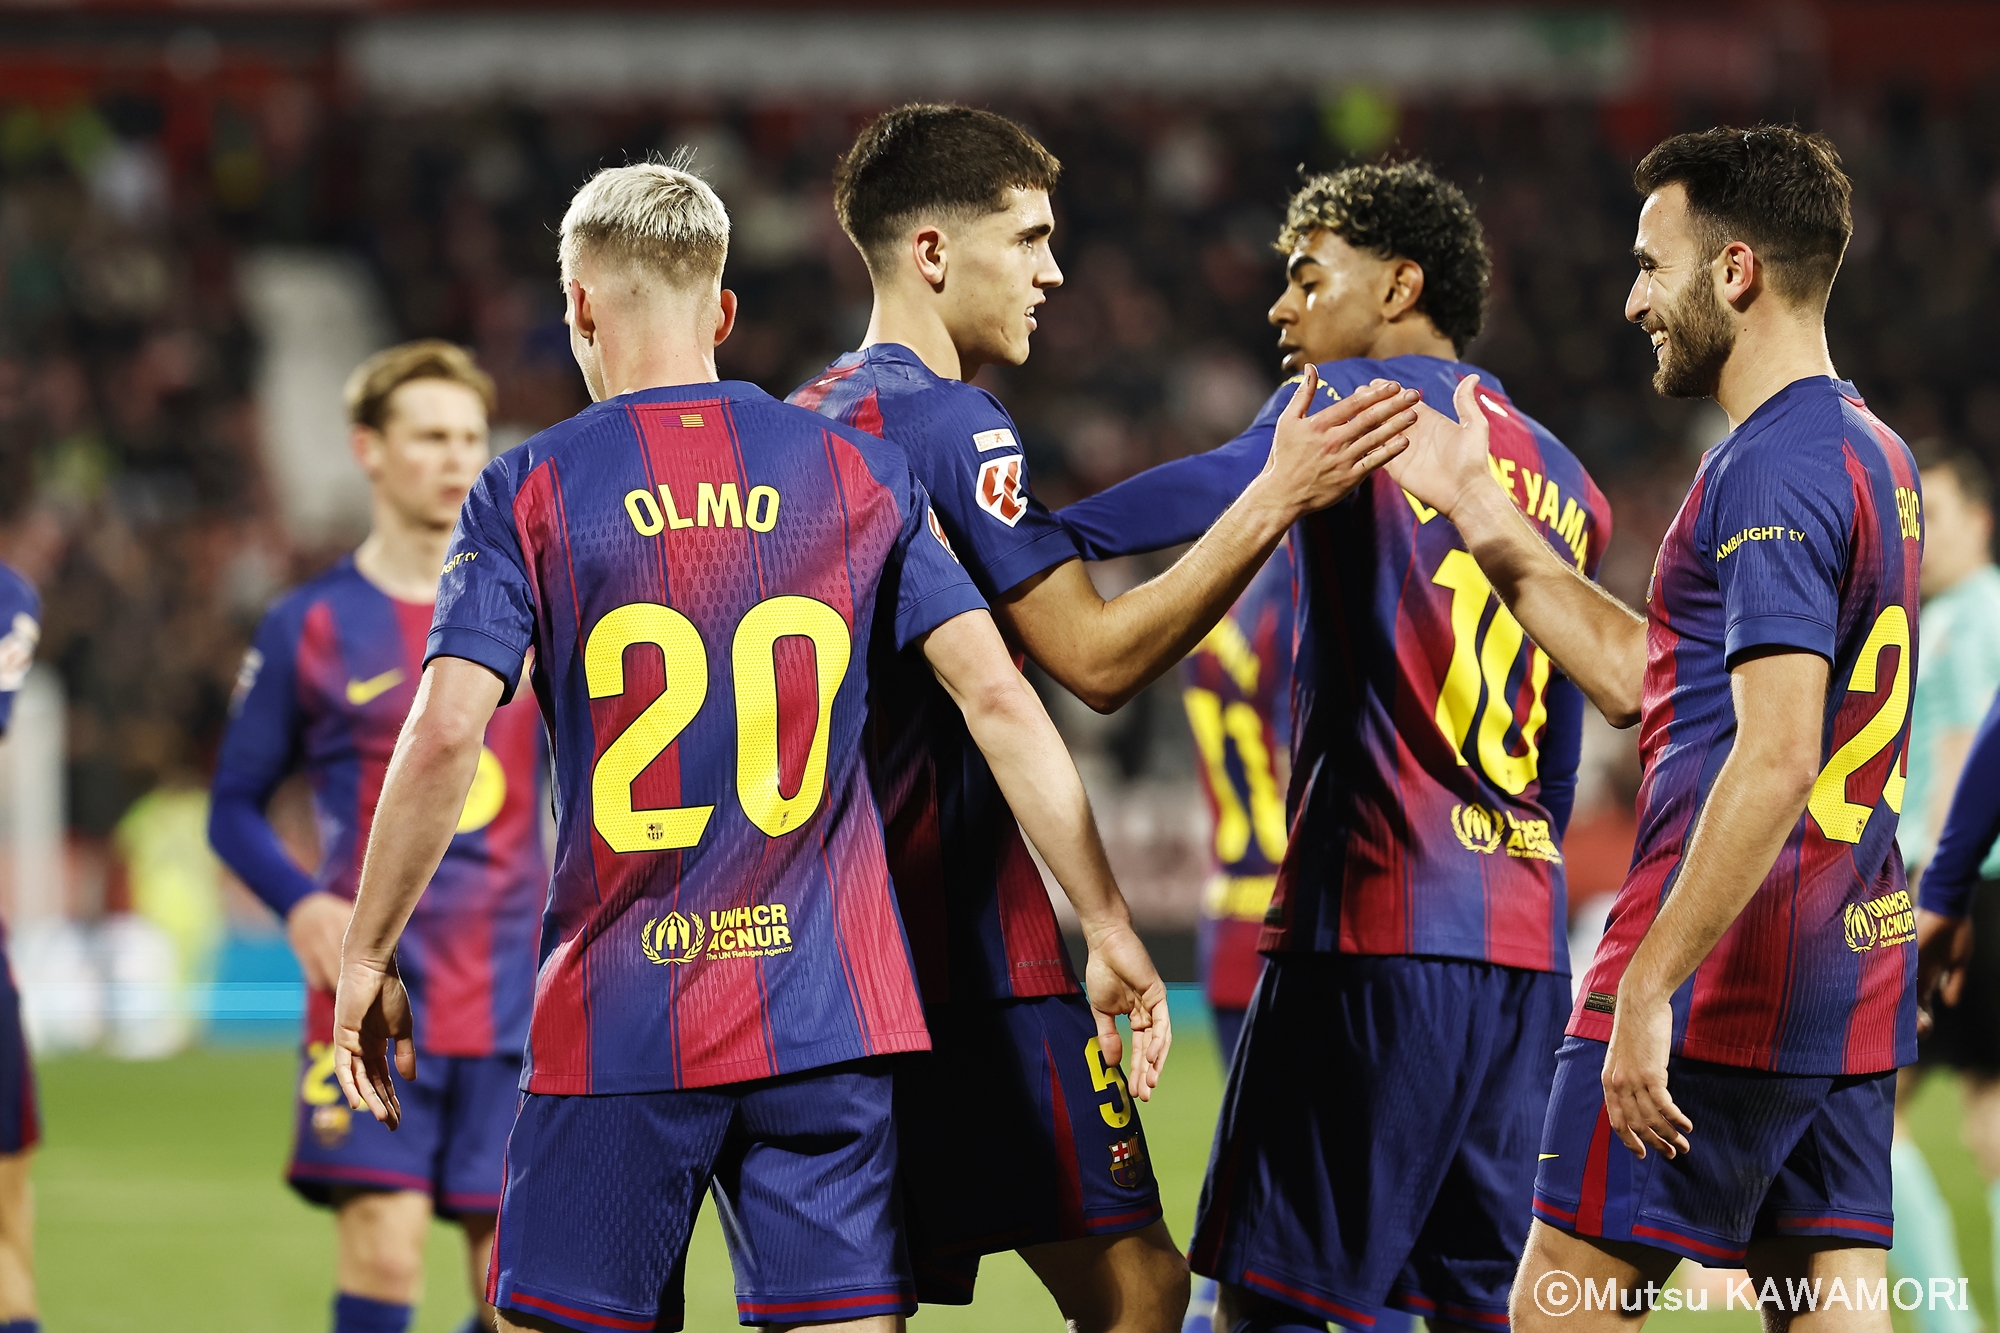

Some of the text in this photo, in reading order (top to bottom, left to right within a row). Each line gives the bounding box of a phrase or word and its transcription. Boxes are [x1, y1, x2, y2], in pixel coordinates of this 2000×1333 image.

[624, 482, 780, 537] OLMO
[1895, 486, 1920, 542] ERIC
[1717, 526, 1805, 562] AMBILIGHT tv
[1431, 548, 1551, 796] 10
[584, 595, 851, 854] 20
[710, 903, 788, 932] UNHCR
[1868, 890, 1911, 918] UNHCR
[706, 925, 793, 953] ACNUR
[1880, 910, 1915, 939] ACNUR
[718, 951, 731, 960] UN
[732, 949, 764, 958] Refugee
[764, 945, 793, 957] Agency
[1084, 1035, 1132, 1129] 5
